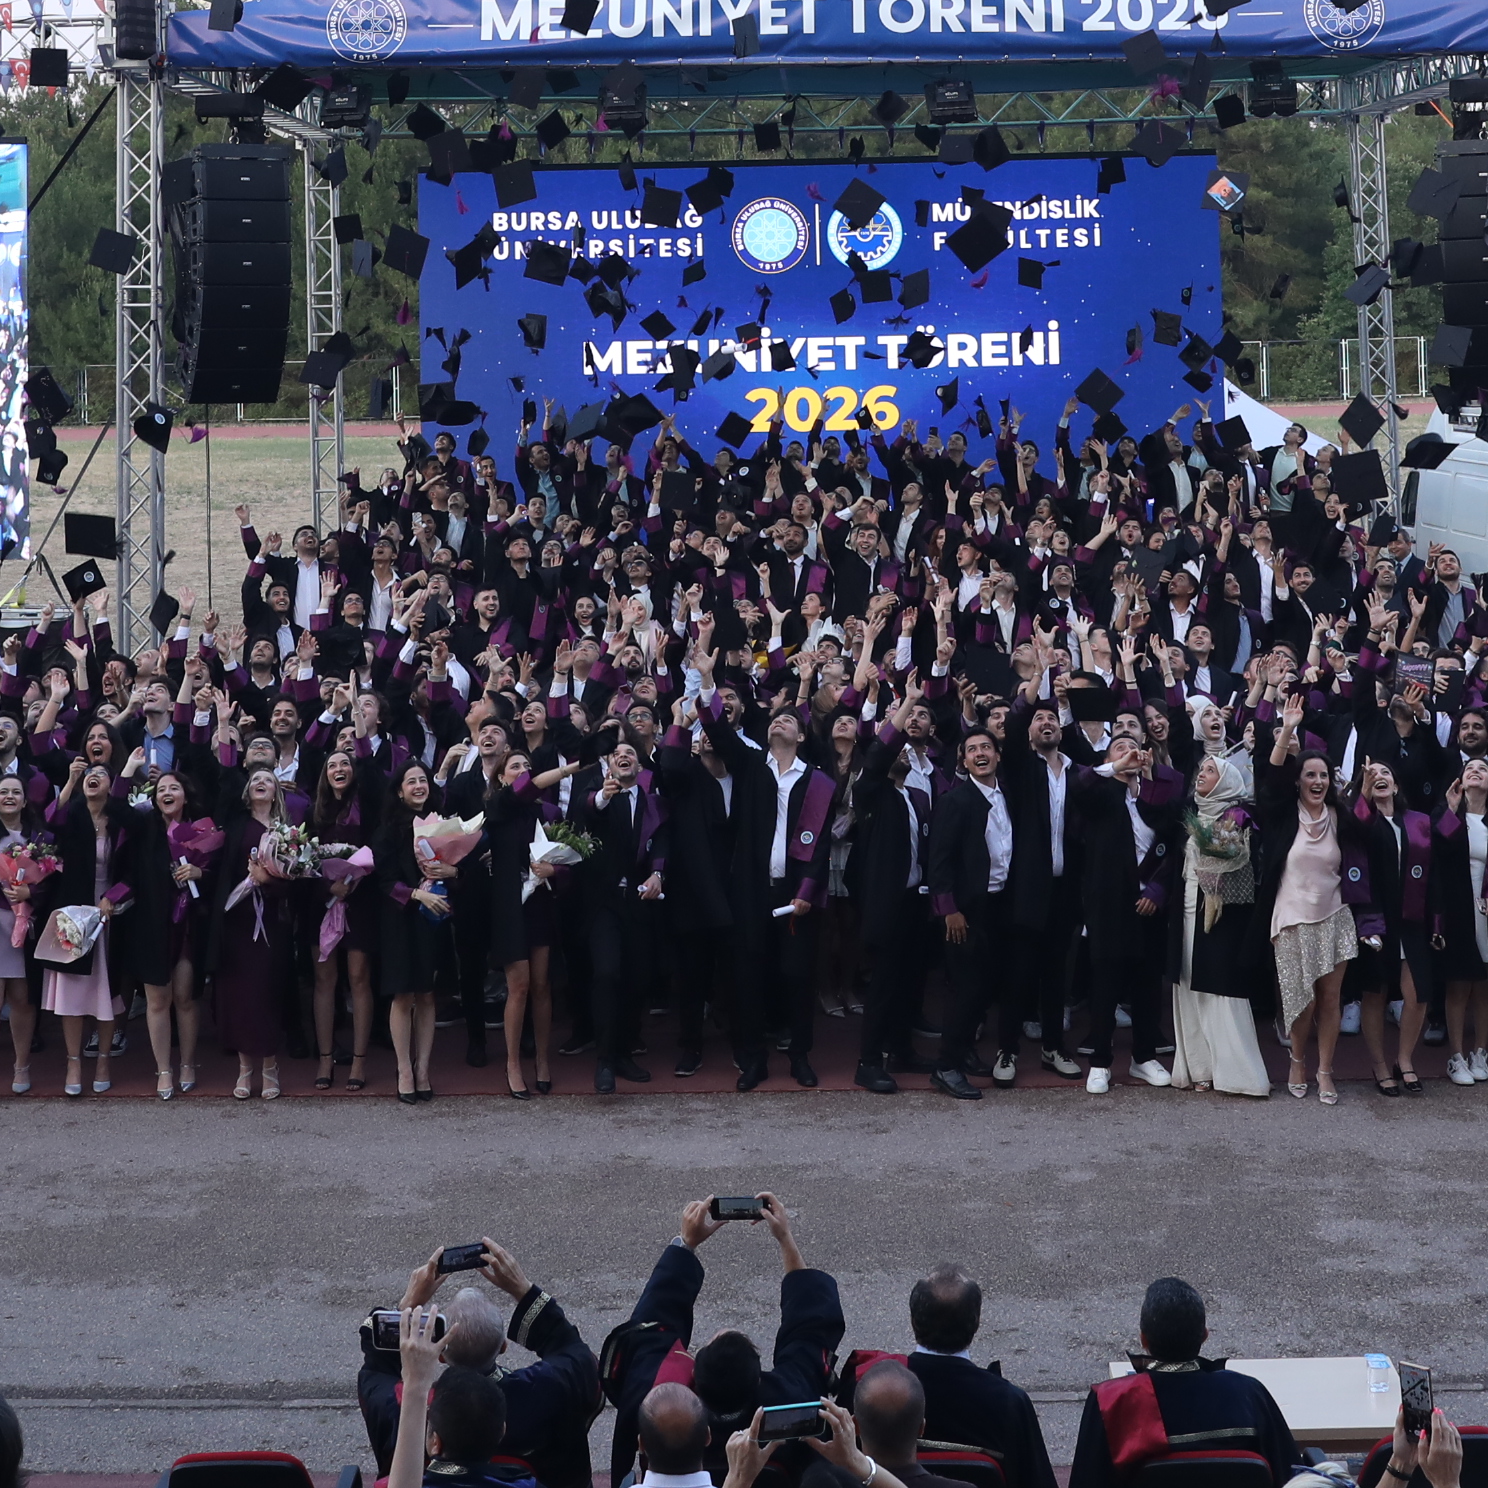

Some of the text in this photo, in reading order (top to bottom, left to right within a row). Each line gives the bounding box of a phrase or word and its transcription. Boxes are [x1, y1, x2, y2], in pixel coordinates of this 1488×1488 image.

[329, 10, 340, 41] BURSA
[353, 53, 378, 61] 1975
[1333, 39, 1358, 48] 1975
[492, 203, 704, 232] BURSA ULUĞ
[931, 194, 1100, 223] MÜNDİSLİK
[492, 232, 704, 261] ÜNRSİTESİ
[735, 222, 745, 251] BURSA
[933, 222, 1102, 252] FLTESİ
[758, 261, 784, 270] 1975
[745, 384, 900, 433] 2026
